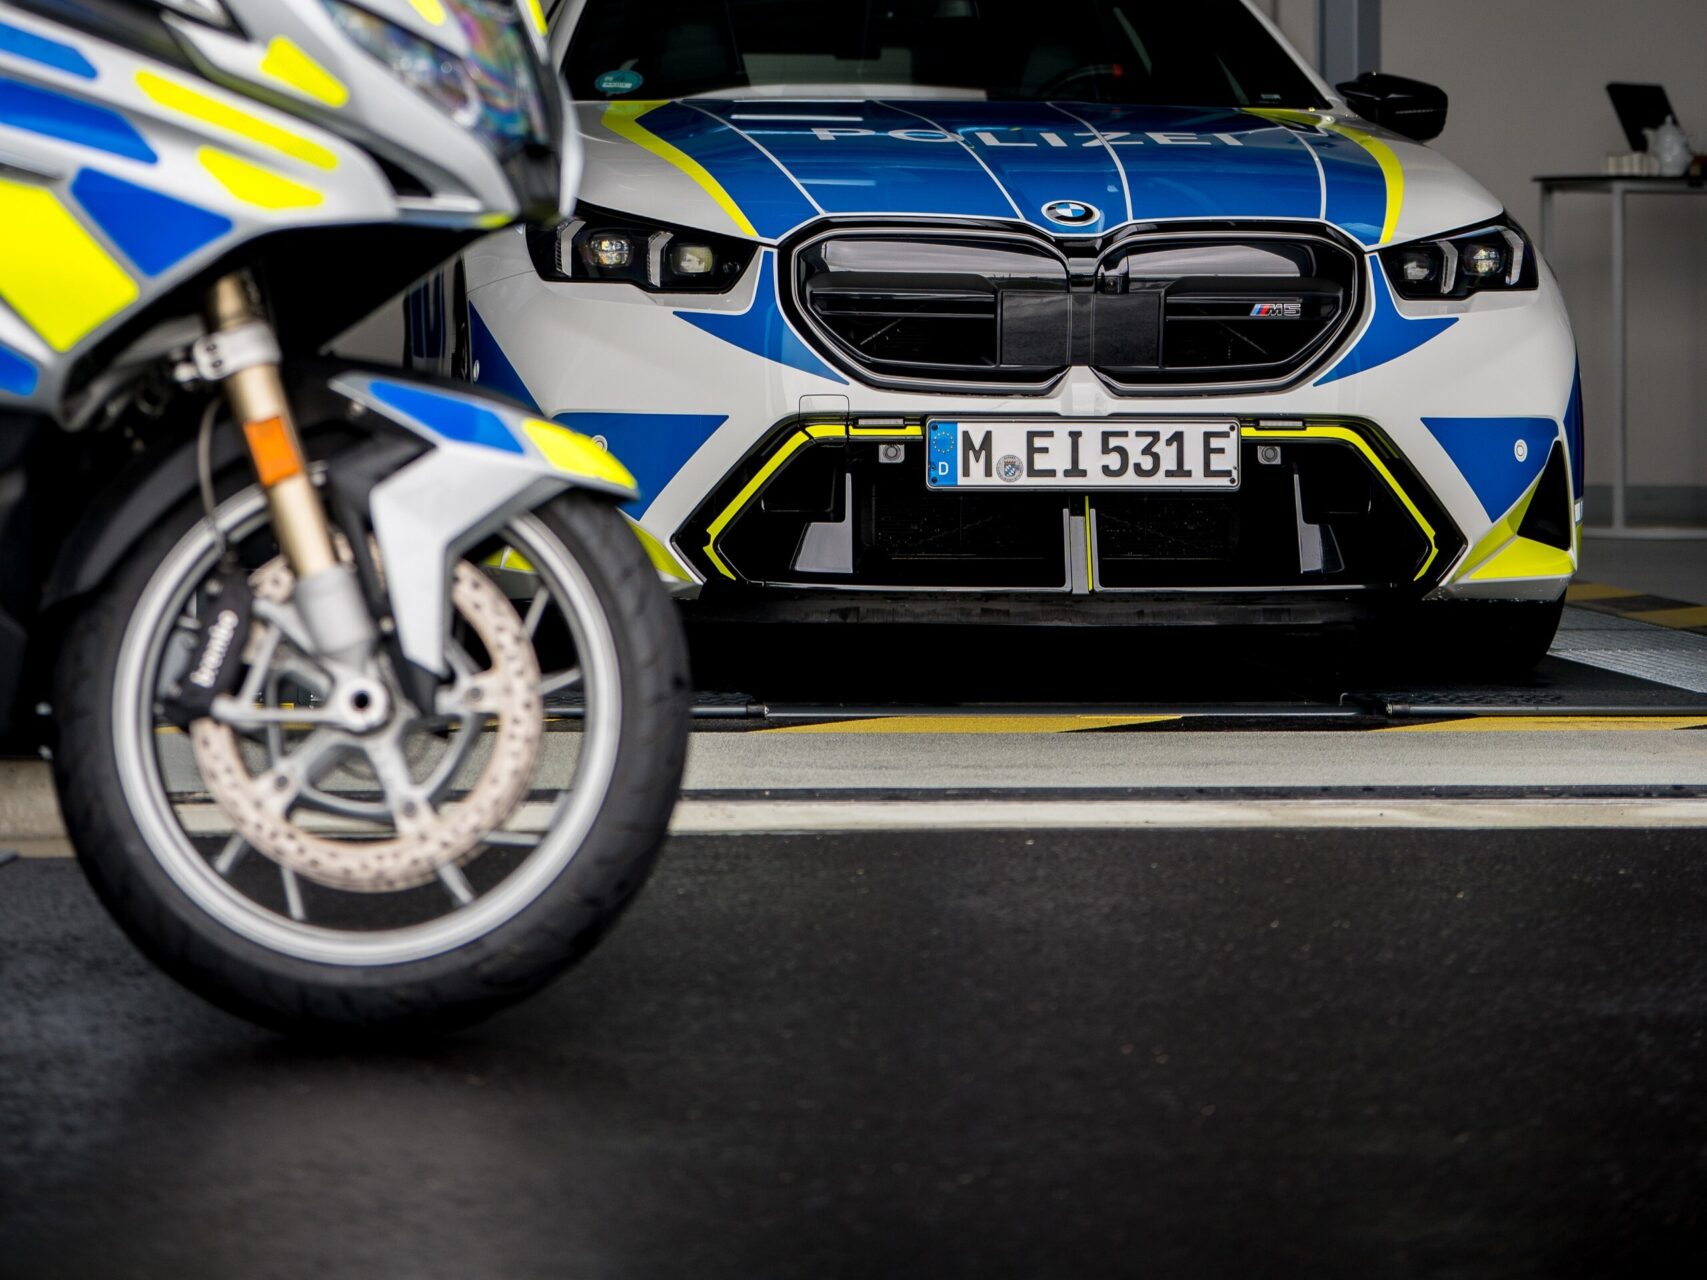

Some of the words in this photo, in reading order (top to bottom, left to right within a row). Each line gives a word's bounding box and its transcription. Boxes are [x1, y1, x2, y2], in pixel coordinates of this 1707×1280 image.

[811, 127, 1244, 147] POLIZEI
[1249, 303, 1301, 317] M5
[962, 430, 993, 478] M
[938, 461, 949, 476] D
